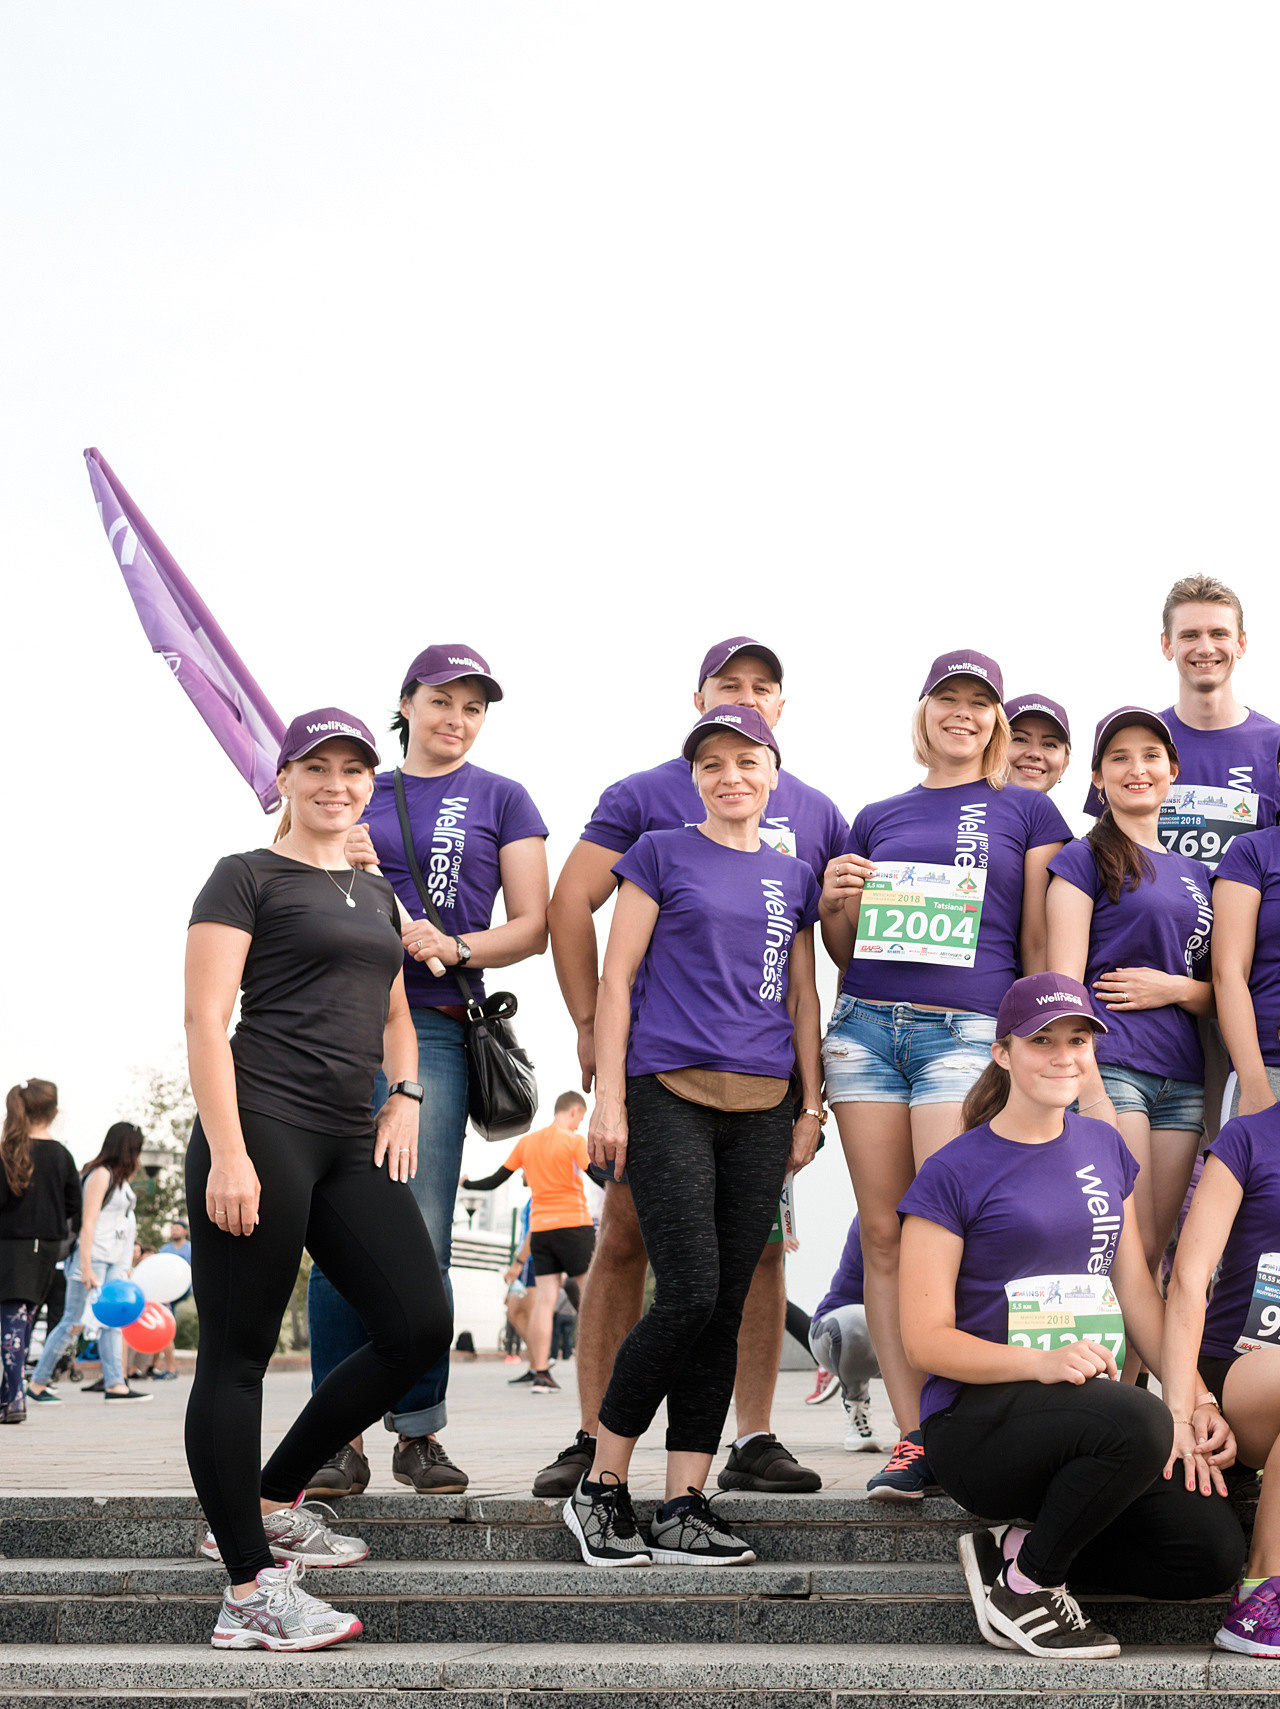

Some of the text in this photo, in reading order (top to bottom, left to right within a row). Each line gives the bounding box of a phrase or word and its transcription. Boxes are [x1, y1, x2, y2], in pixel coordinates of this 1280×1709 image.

[953, 802, 988, 868] Wellne
[1180, 816, 1201, 825] 2018
[444, 856, 463, 909] ORIFLAME
[898, 894, 920, 903] 2018
[864, 908, 975, 945] 12004
[933, 902, 963, 912] Tatsiana
[759, 879, 793, 1001] Wellness
[774, 950, 788, 1003] ORIFLAME
[1075, 1164, 1121, 1275] Wellne
[1047, 1315, 1070, 1325] 2018
